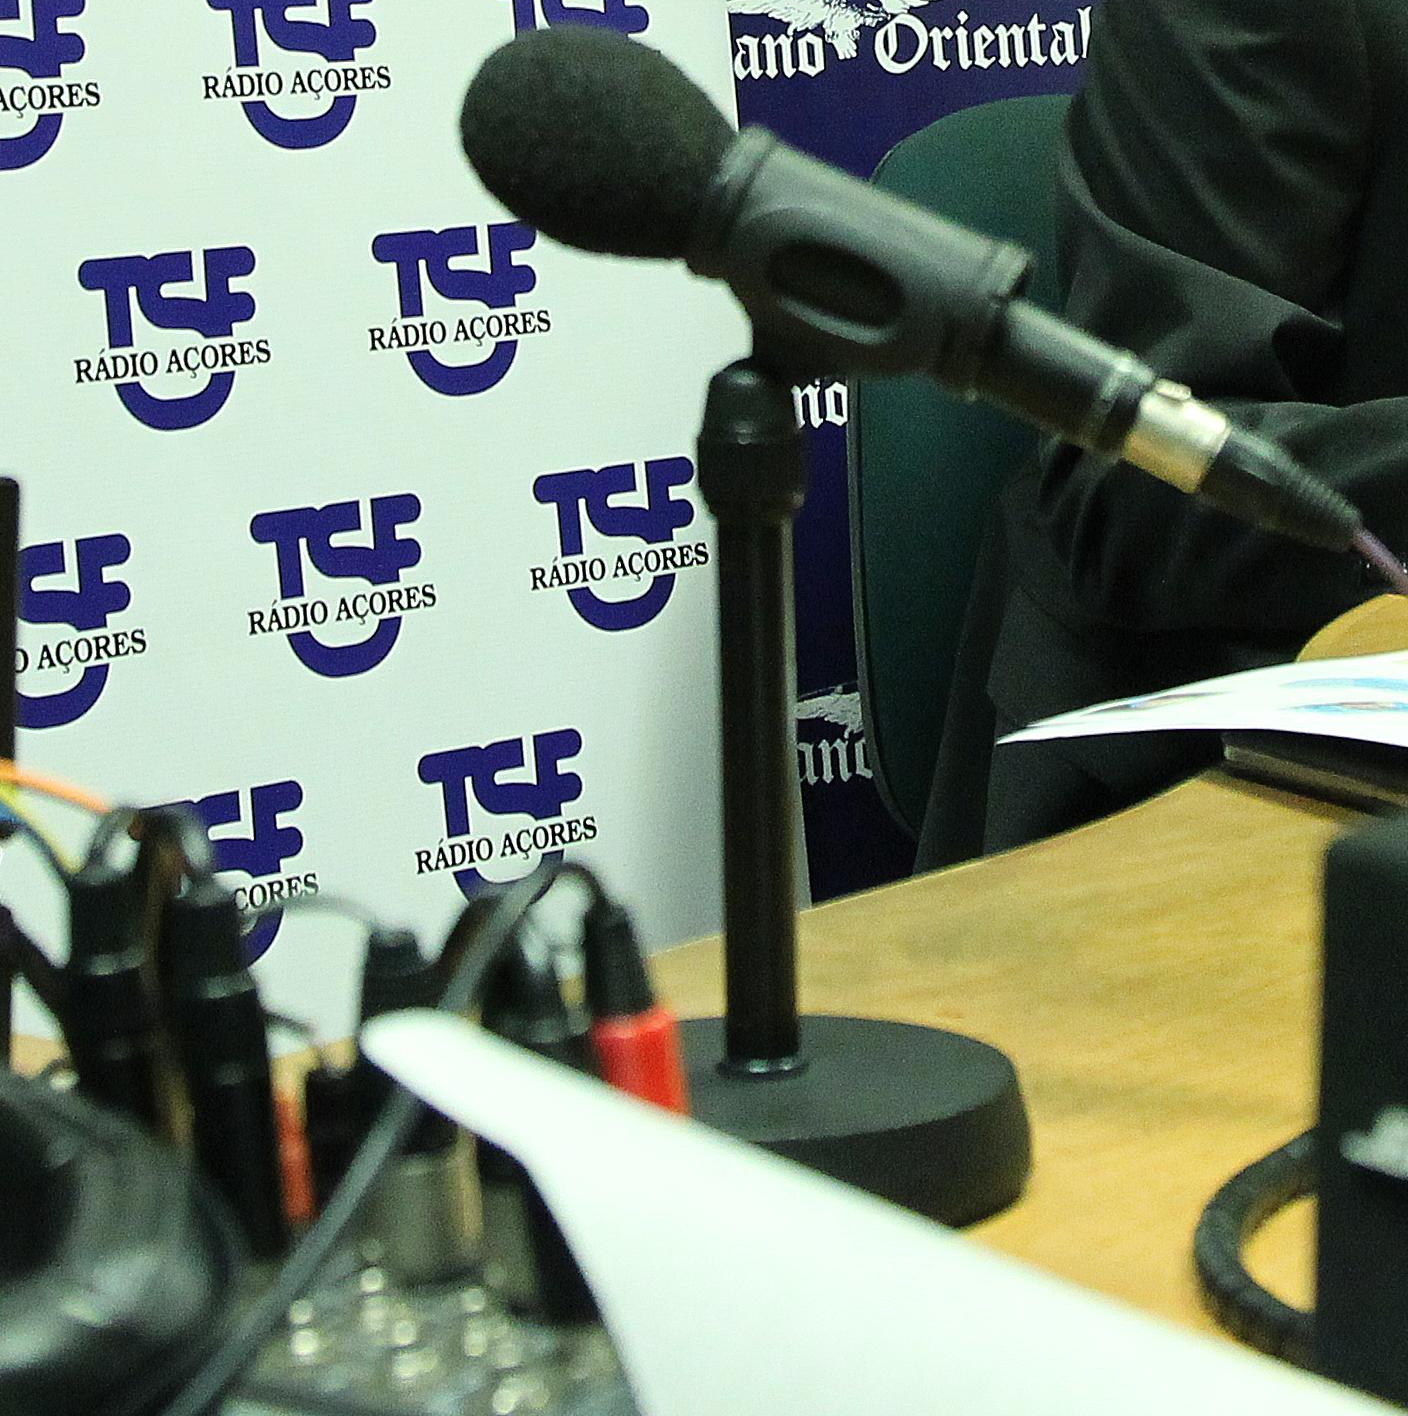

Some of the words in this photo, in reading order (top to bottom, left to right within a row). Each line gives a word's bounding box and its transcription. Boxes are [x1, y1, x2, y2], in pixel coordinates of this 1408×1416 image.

[874, 6, 1092, 74] Oriental
[201, 66, 284, 100] RÁDIO
[290, 66, 392, 101] AÇORES
[367, 317, 447, 352] RÁDIO
[453, 310, 552, 347] AÇORES
[73, 350, 159, 384] RÁDIO
[165, 339, 272, 379] AÇORES
[530, 557, 606, 592] RÁDIO
[612, 541, 710, 582] AÇORES
[247, 599, 329, 636] RÁDIO
[335, 583, 437, 626] AÇORES
[37, 628, 147, 674] AÇORES
[415, 836, 494, 875] RÁDIO
[500, 815, 598, 861] AÇORES
